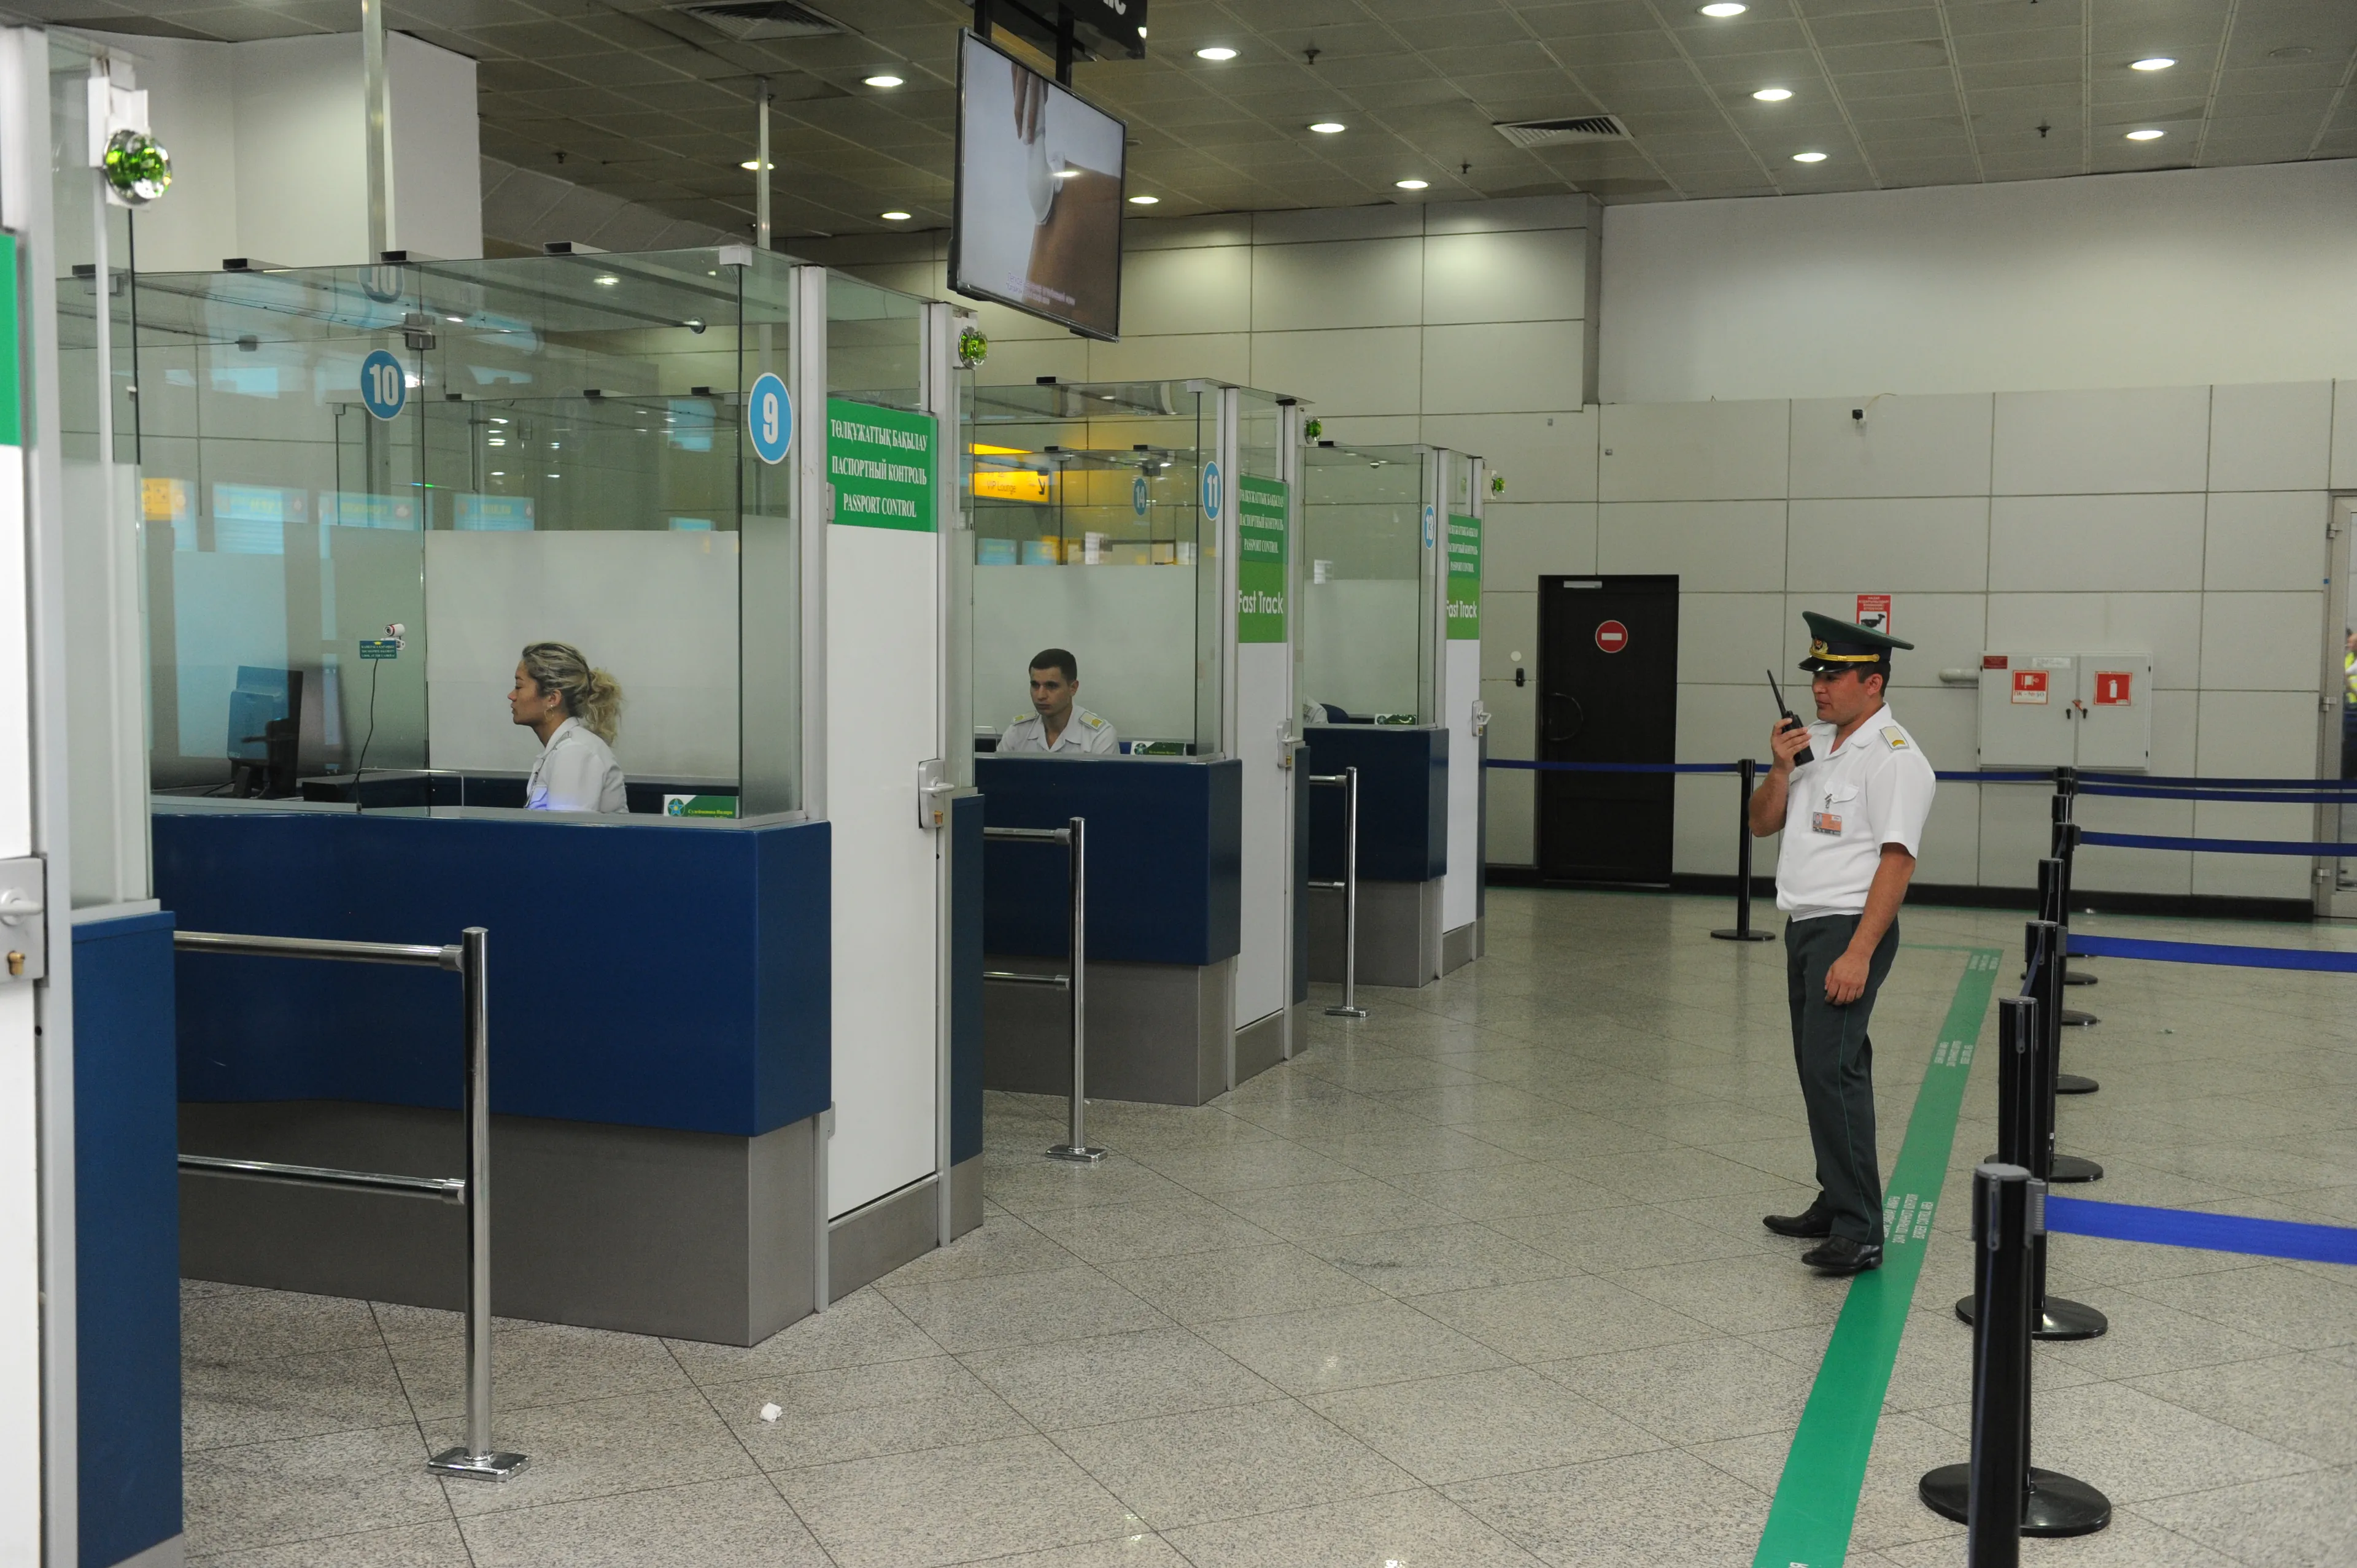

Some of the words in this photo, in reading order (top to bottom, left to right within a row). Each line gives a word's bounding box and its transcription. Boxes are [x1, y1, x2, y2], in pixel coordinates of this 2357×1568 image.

[369, 363, 399, 406] 10
[763, 393, 778, 444] 9
[830, 419, 891, 450] ТӨЛҚҰЖАТТЫҚ
[892, 430, 927, 452] БАҚЫЛАУ
[832, 456, 887, 480] ПАСПОРТНЫЙ
[888, 463, 927, 485] КОНТРОЛЬ
[1136, 486, 1145, 508] 14
[1207, 474, 1218, 508] 11
[843, 493, 881, 514] PASSPORT
[881, 497, 916, 517] CONTROL
[1426, 515, 1433, 540] 13
[1244, 538, 1261, 552] PASSPORT
[1262, 540, 1279, 553] CONTROL
[1238, 590, 1256, 613] Fast
[1258, 591, 1283, 614] Track
[1460, 600, 1477, 618] Track
